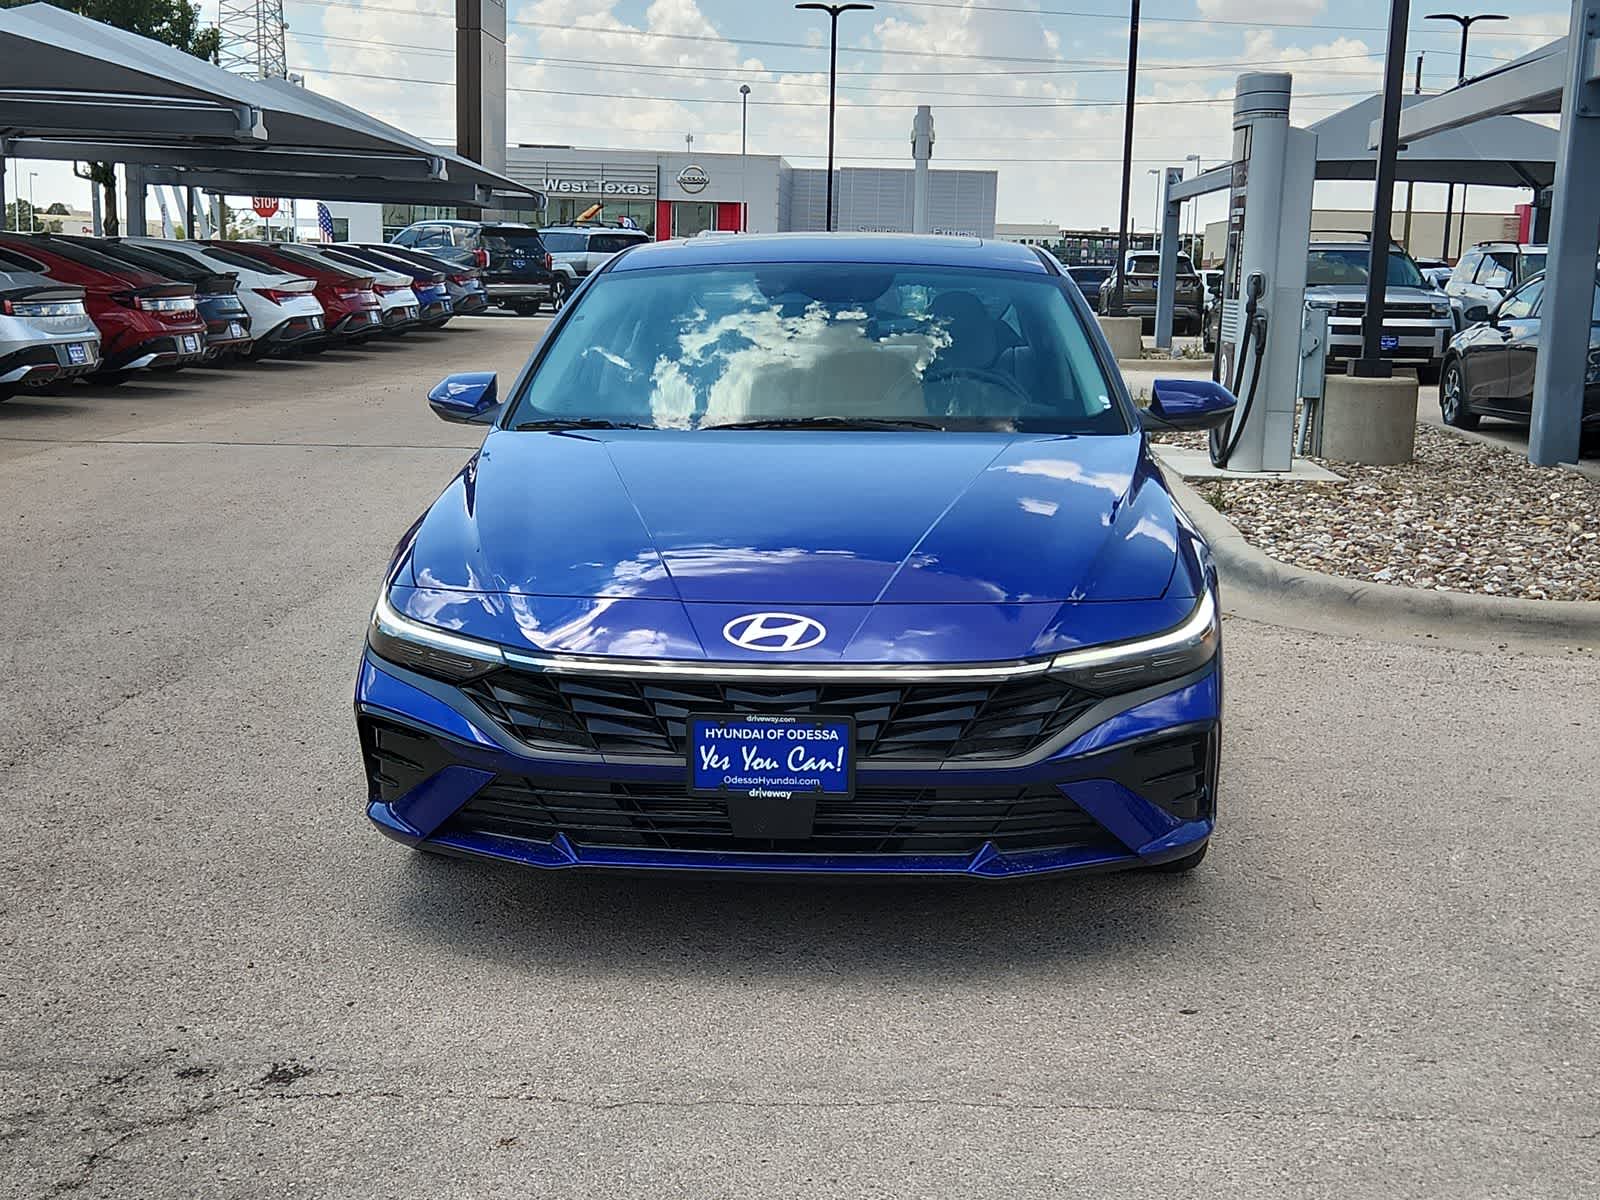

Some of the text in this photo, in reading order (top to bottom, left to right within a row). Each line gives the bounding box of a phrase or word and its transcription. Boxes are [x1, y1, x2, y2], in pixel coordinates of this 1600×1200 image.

[542, 179, 650, 194] West Texas
[254, 197, 277, 208] STOP
[746, 714, 796, 724] driveway.com
[705, 728, 839, 740] HYUNDAI OF ODESSA
[700, 744, 844, 772] Yes You Can!
[723, 775, 820, 786] OdessaHyundai.com
[748, 787, 793, 800] driveway
